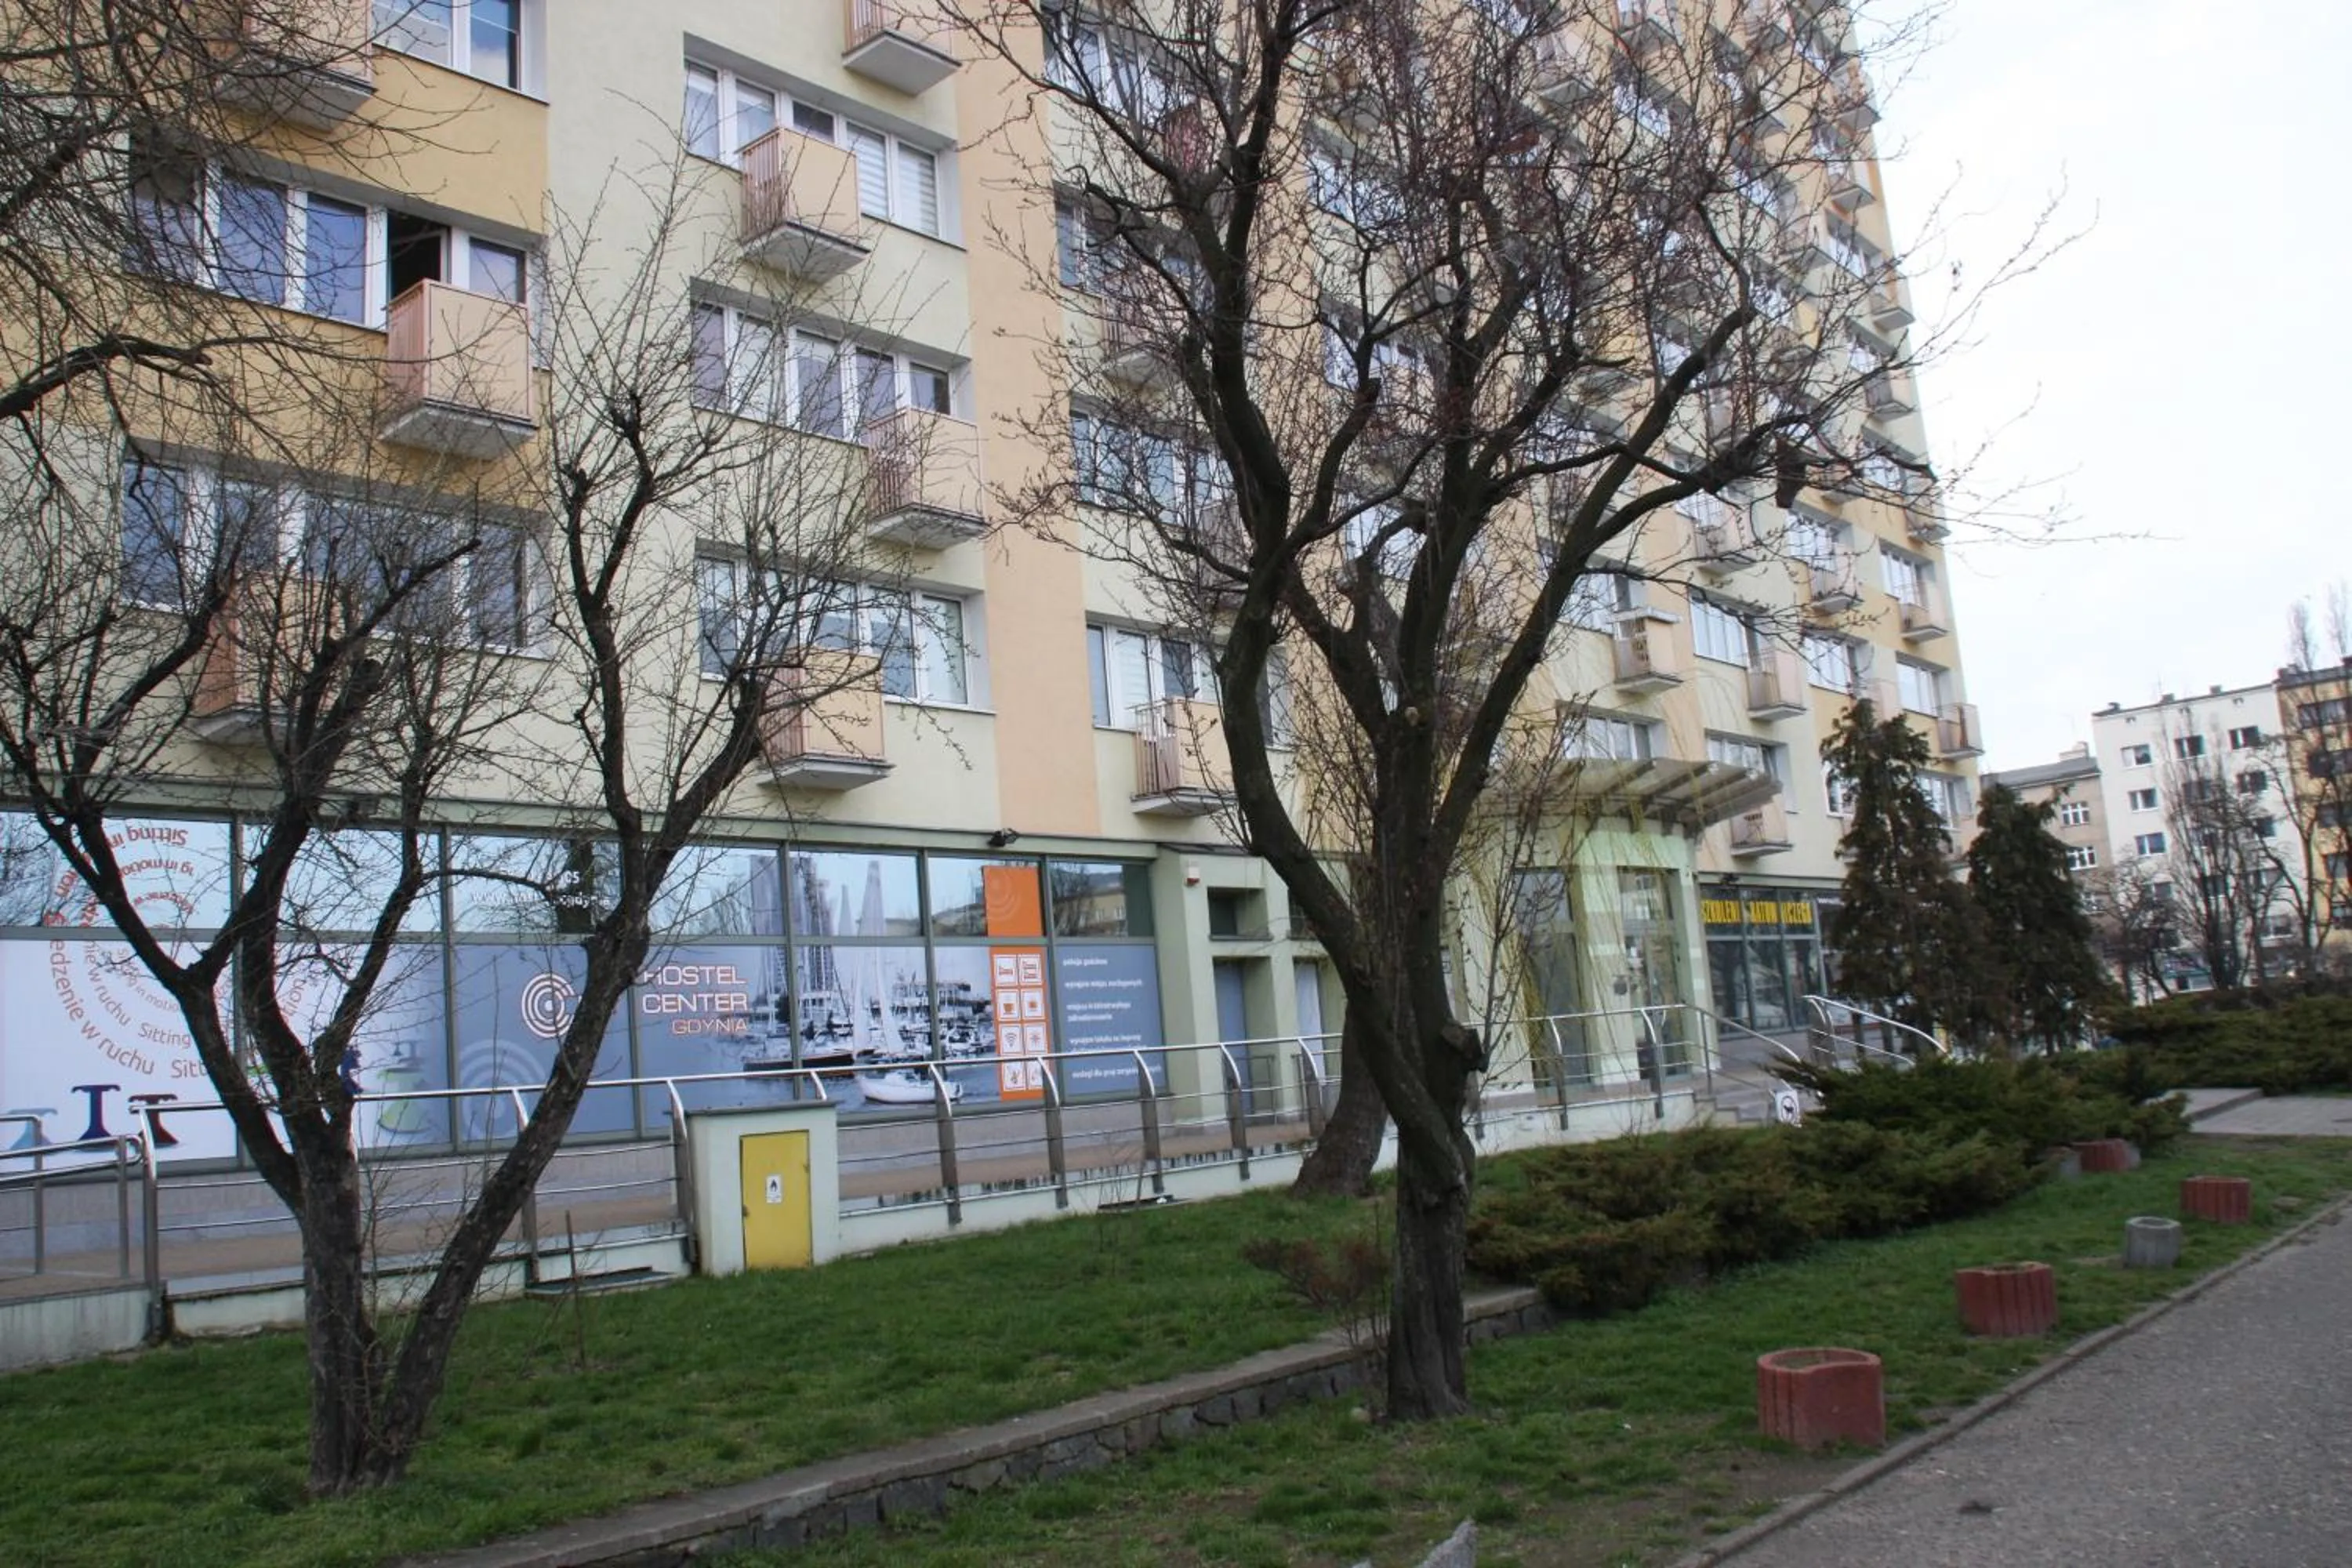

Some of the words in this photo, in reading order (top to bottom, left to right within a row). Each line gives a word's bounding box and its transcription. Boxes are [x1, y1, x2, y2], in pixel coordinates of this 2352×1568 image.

[125, 826, 188, 846] Sitting
[119, 858, 164, 877] motio
[644, 965, 748, 985] HOSTEL
[146, 993, 180, 1013] motio
[642, 993, 748, 1014] CENTER
[94, 984, 132, 1027] ruchu
[138, 1022, 192, 1049] Sitting
[672, 1018, 748, 1034] GDYNIA
[81, 1020, 101, 1040] w
[98, 1037, 155, 1075] ruchu
[171, 1058, 210, 1079] Sitt
